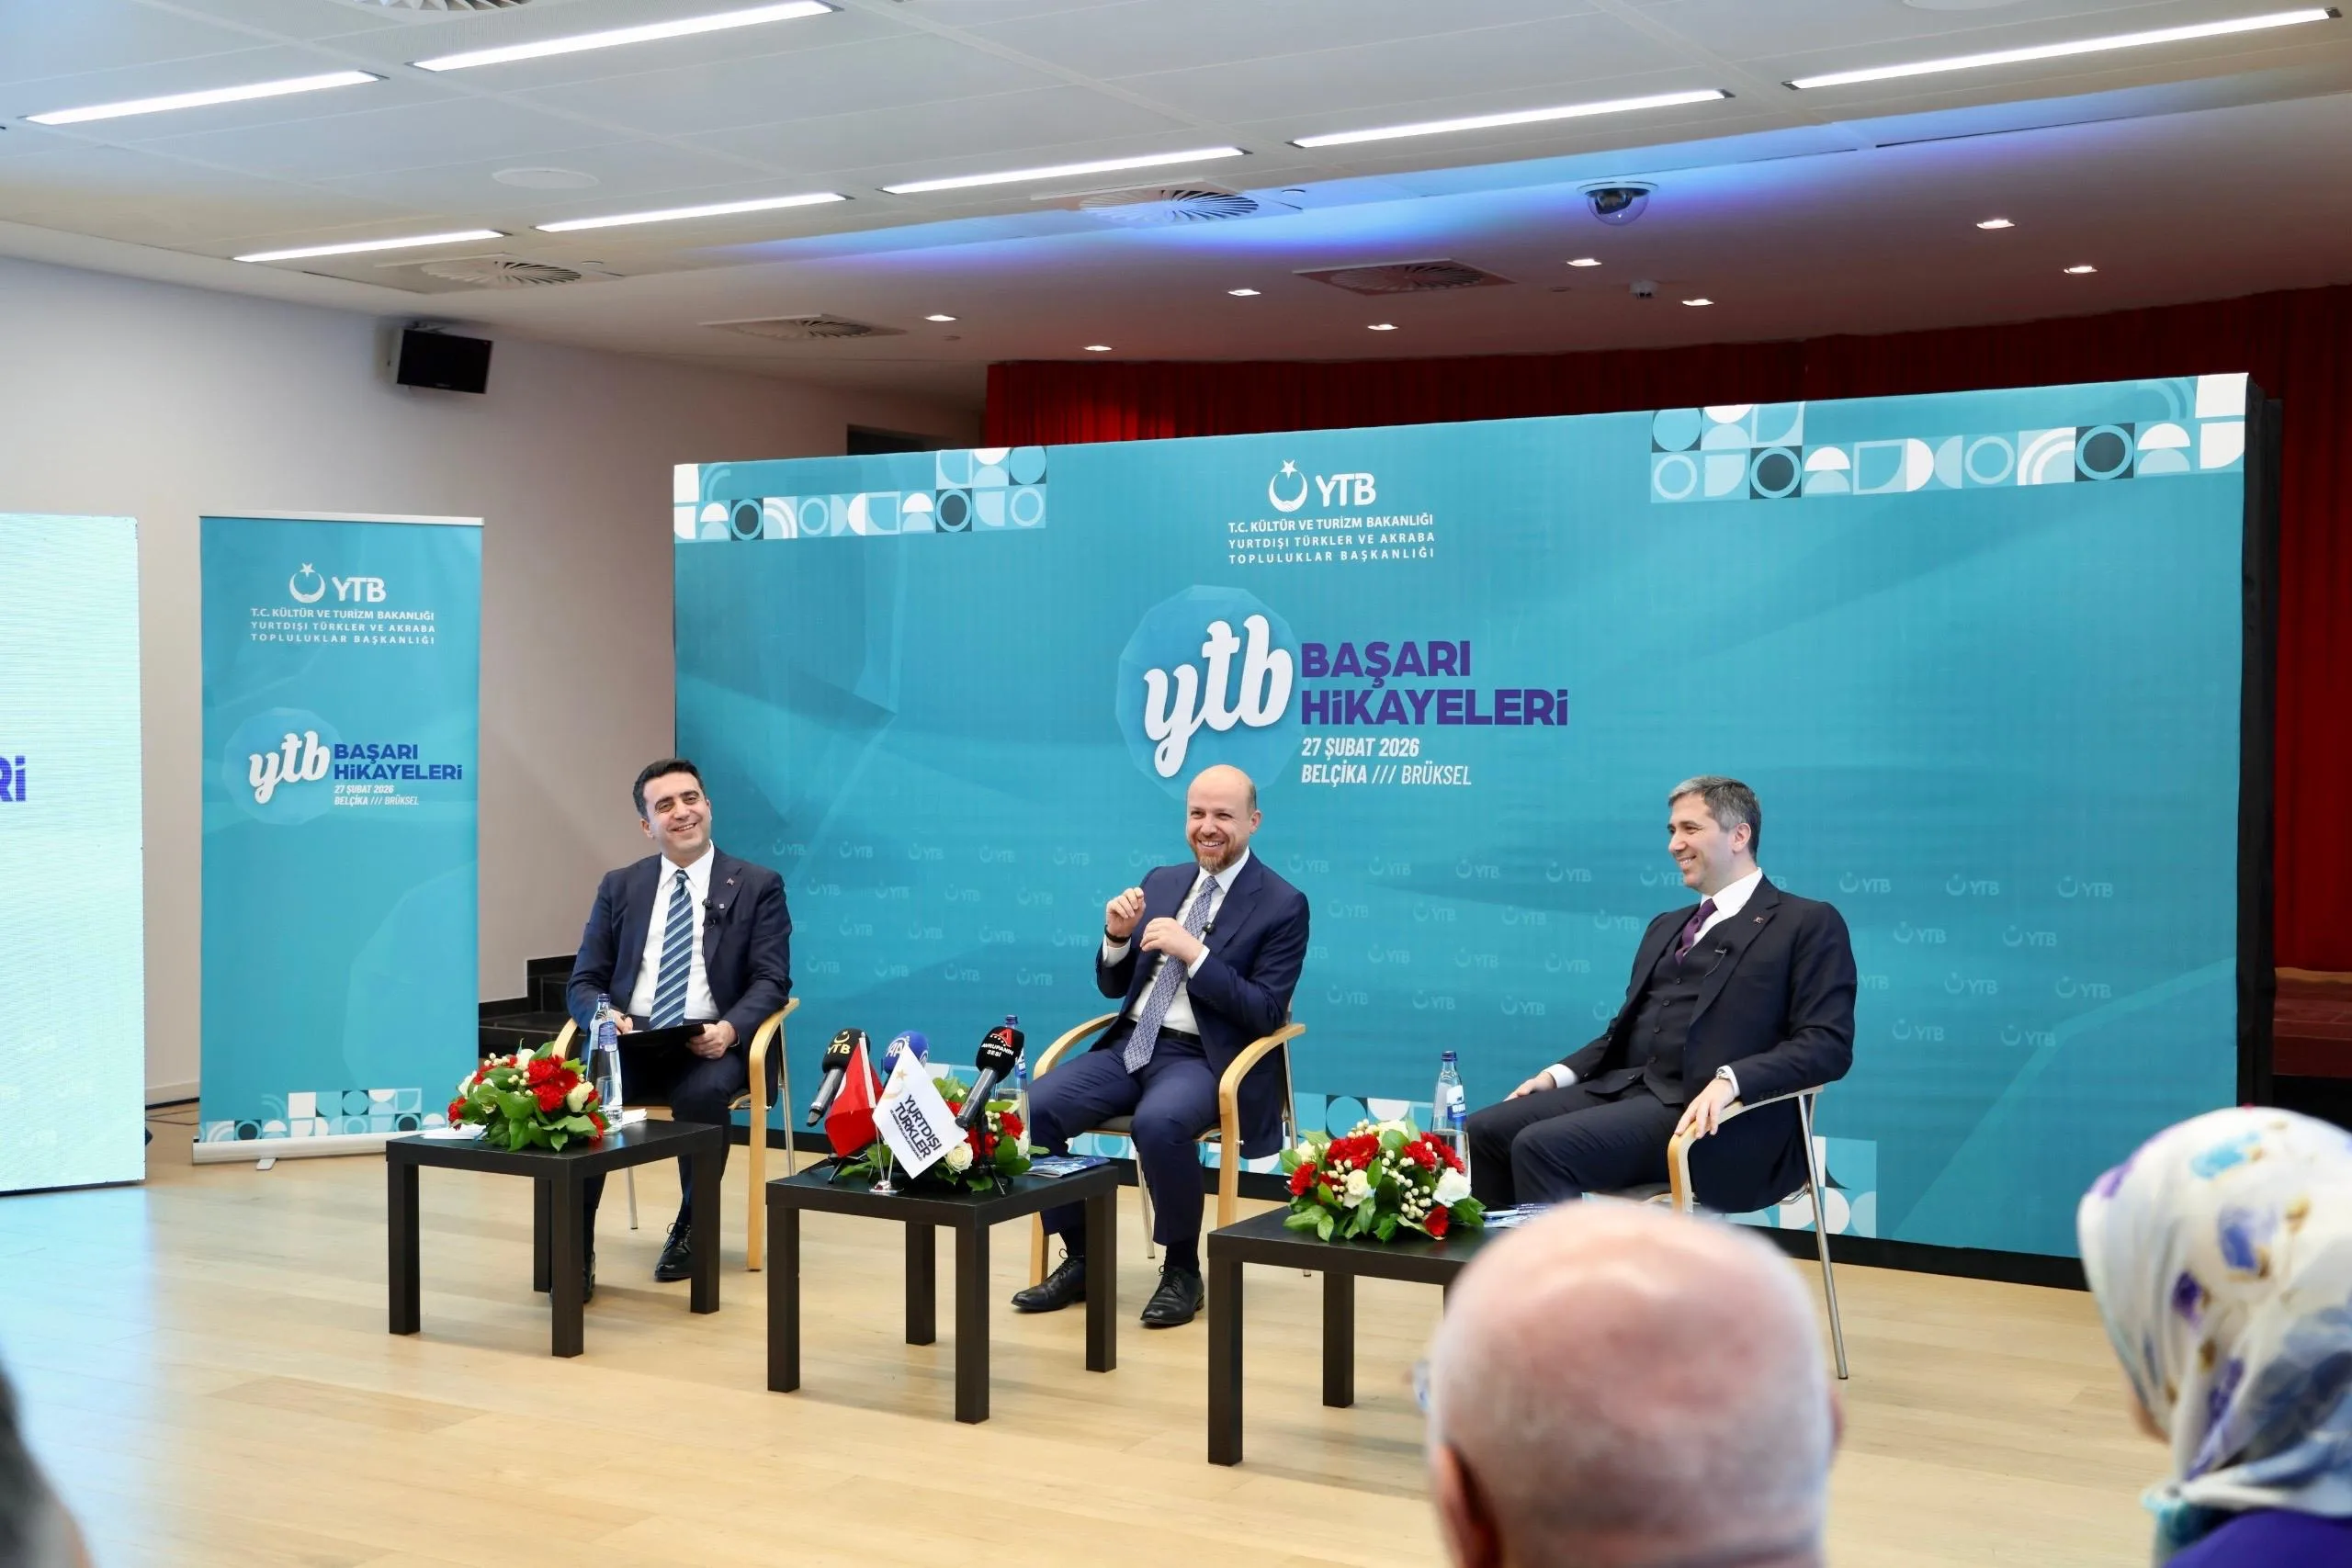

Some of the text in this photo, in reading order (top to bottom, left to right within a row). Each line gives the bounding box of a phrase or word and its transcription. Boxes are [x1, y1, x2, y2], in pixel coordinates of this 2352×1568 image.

[1315, 473, 1376, 507] YTB
[1228, 512, 1433, 533] T.C. KÜLTÜR VE TURİZM BAKANLIĞI
[1228, 532, 1434, 550] YURTDIŞI TÜRKLER VE AKRABA
[1228, 547, 1433, 564] TOPLULUKLAR BAŞKANLIĞI
[331, 577, 387, 603] YTB
[251, 607, 435, 621] T.C. KÜLTÜR VE TURİZM BAKANLIĞI
[251, 621, 435, 633] YURTDIŞI TÜRKLER VE AKRABA
[251, 634, 435, 645] TOPLULUKLAR BAŞKANLIĞI
[1301, 640, 1470, 688] BAŞARI
[1143, 615, 1294, 778] ytb
[334, 744, 418, 764] BAŞARI
[1301, 738, 1420, 761] 27 ŞUBAT 2026
[249, 730, 331, 804] ytb
[1301, 760, 1367, 788] BELÇİKA
[1401, 761, 1472, 785] BRÜKSEL
[334, 784, 395, 795] 27 ŞUBAT 2026
[384, 795, 419, 806] BRÜKSEL
[1475, 865, 1499, 879] YTB
[1566, 868, 1591, 882] YTB
[1861, 878, 1891, 894] YTB
[1969, 881, 1999, 896] YTB
[2082, 883, 2114, 898] YTB
[1917, 929, 1947, 944] YTB
[2026, 931, 2057, 946] YTB
[1860, 974, 1890, 990] YTB
[1967, 979, 1998, 995] YTB
[2080, 983, 2111, 998] YTB
[1915, 1026, 1945, 1041] YTB
[2025, 1032, 2056, 1047] YTB
[827, 1043, 851, 1055] YTB
[895, 1102, 931, 1159] TÜRKLER
[905, 1094, 943, 1151] YURTDIŞI
